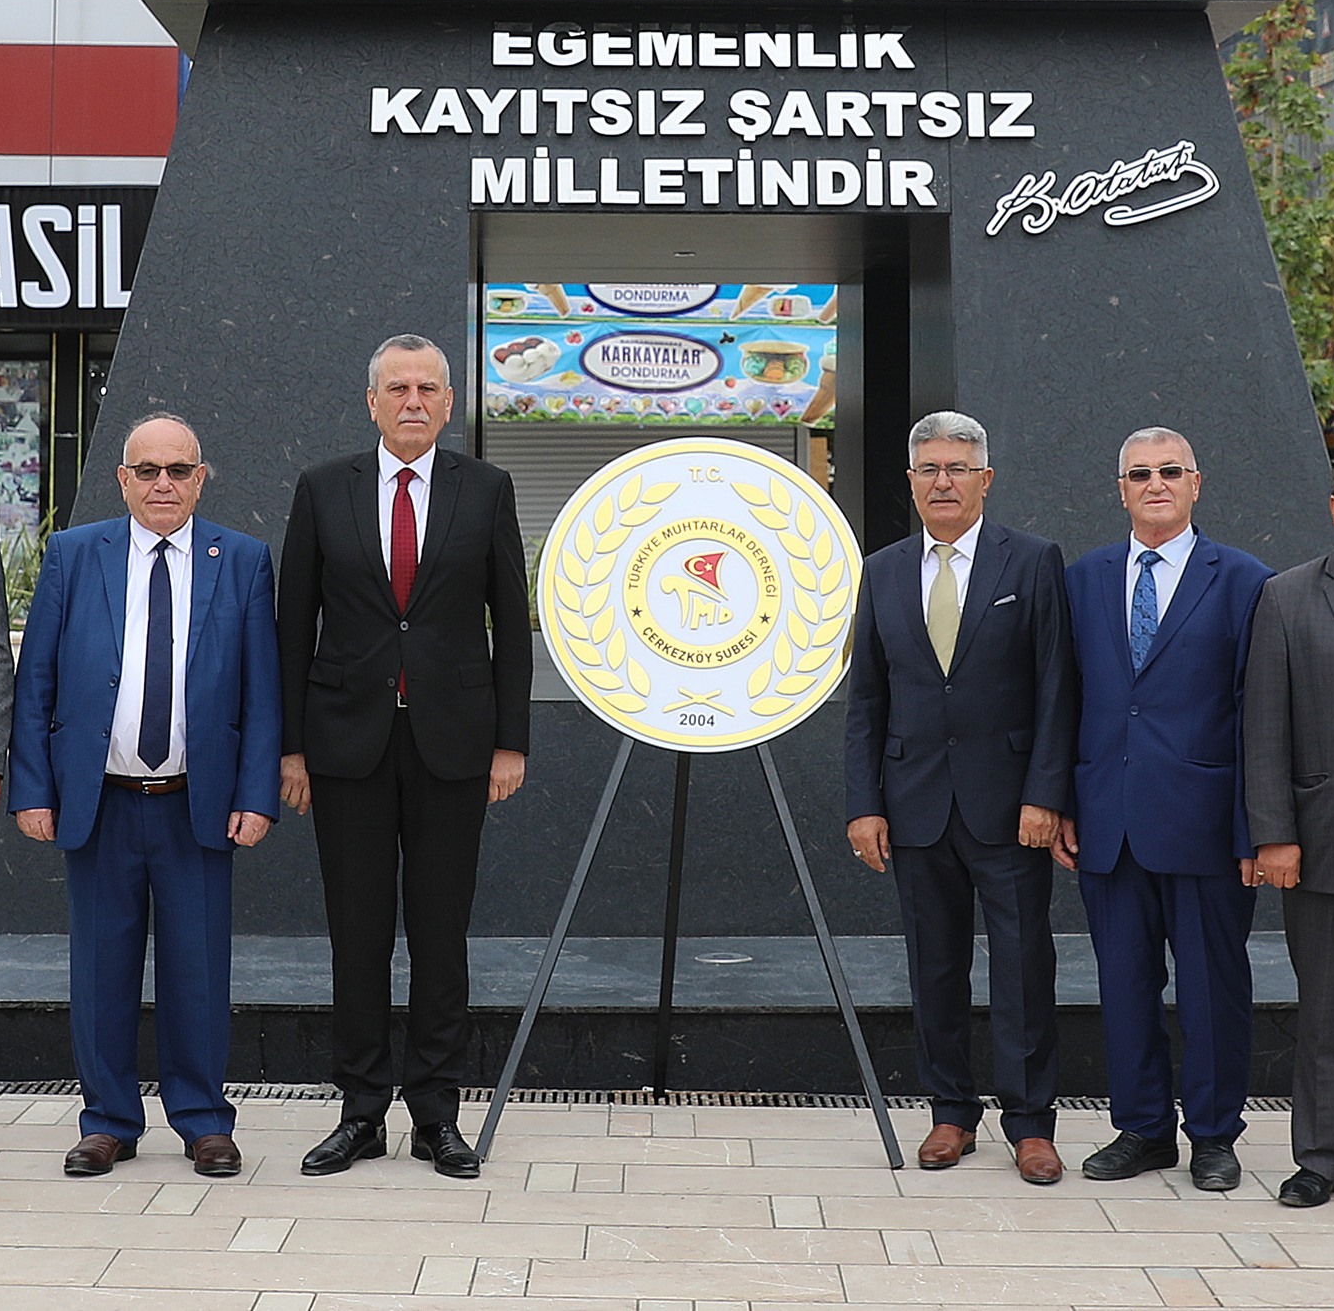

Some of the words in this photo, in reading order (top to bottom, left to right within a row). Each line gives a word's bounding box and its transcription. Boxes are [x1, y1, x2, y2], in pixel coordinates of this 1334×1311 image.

[491, 15, 918, 69] EGEMENLİK
[370, 86, 708, 136] KAYITSIZ
[727, 88, 1037, 143] ŞARTSIZ
[468, 145, 939, 209] MİLLETİNDİR
[614, 289, 690, 302] DONDURMA
[601, 344, 701, 365] KARKAYALAR
[611, 365, 691, 380] DONDURMA
[688, 465, 725, 483] T.C.
[628, 535, 662, 591] TÜRKİYE
[661, 519, 746, 545] MUHTARLAR
[745, 539, 779, 598] DERNEĞİ
[641, 626, 714, 664] ÇERKEZKÖY
[714, 628, 759, 663] ŞUBESİ
[678, 712, 716, 728] 2004
